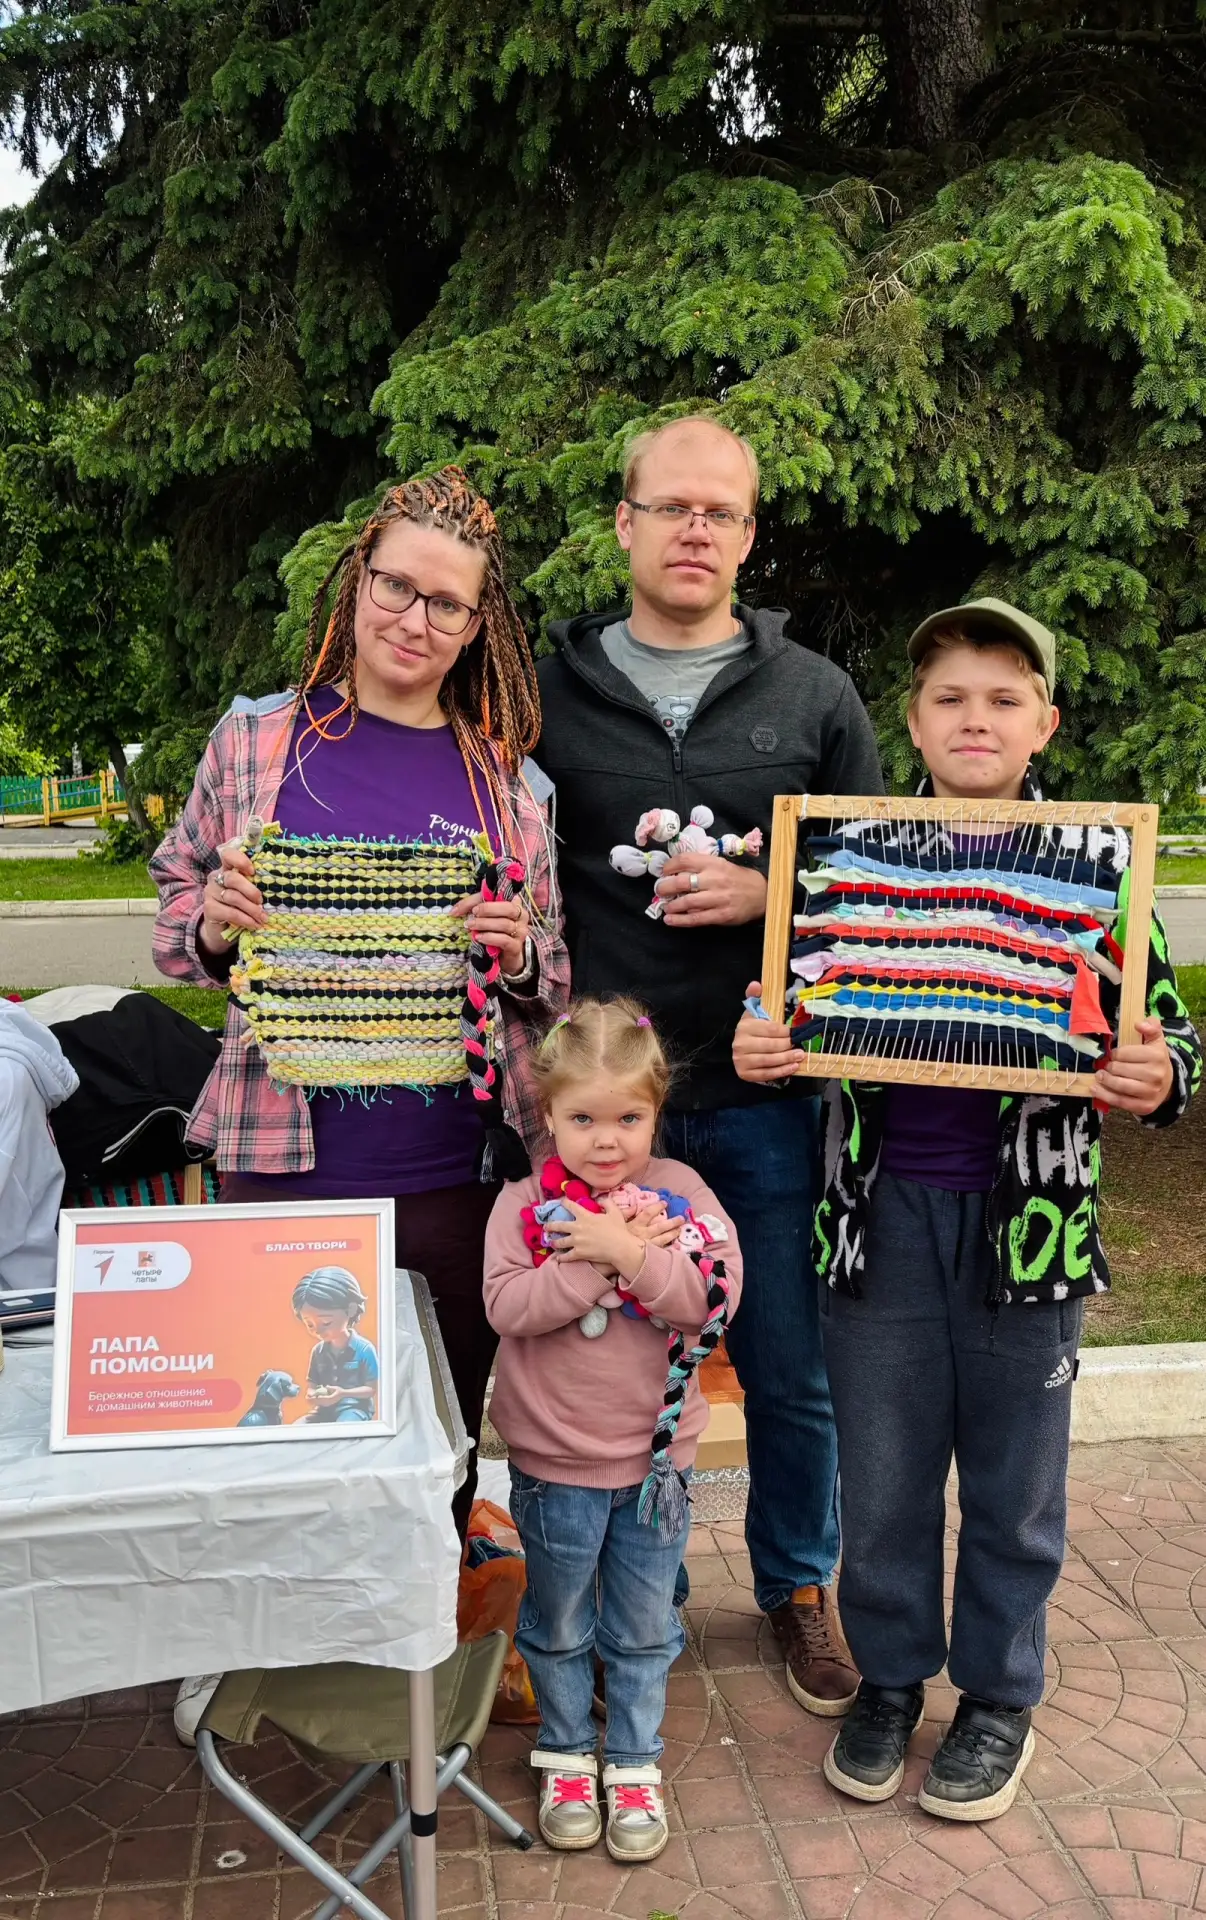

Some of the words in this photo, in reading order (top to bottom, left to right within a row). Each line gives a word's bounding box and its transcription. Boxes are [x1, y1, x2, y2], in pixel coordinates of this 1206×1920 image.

[265, 1242, 305, 1253] БЛАГО
[306, 1240, 347, 1251] ТВОРИ
[132, 1268, 162, 1277] четыре
[135, 1276, 157, 1284] лапы
[89, 1335, 160, 1354] ЛАПА
[90, 1353, 214, 1375] ПОМОЩИ
[88, 1391, 144, 1402] Бережное
[146, 1388, 206, 1399] отношение
[88, 1404, 94, 1412] к
[95, 1400, 156, 1412] домашним
[158, 1398, 213, 1409] животным
